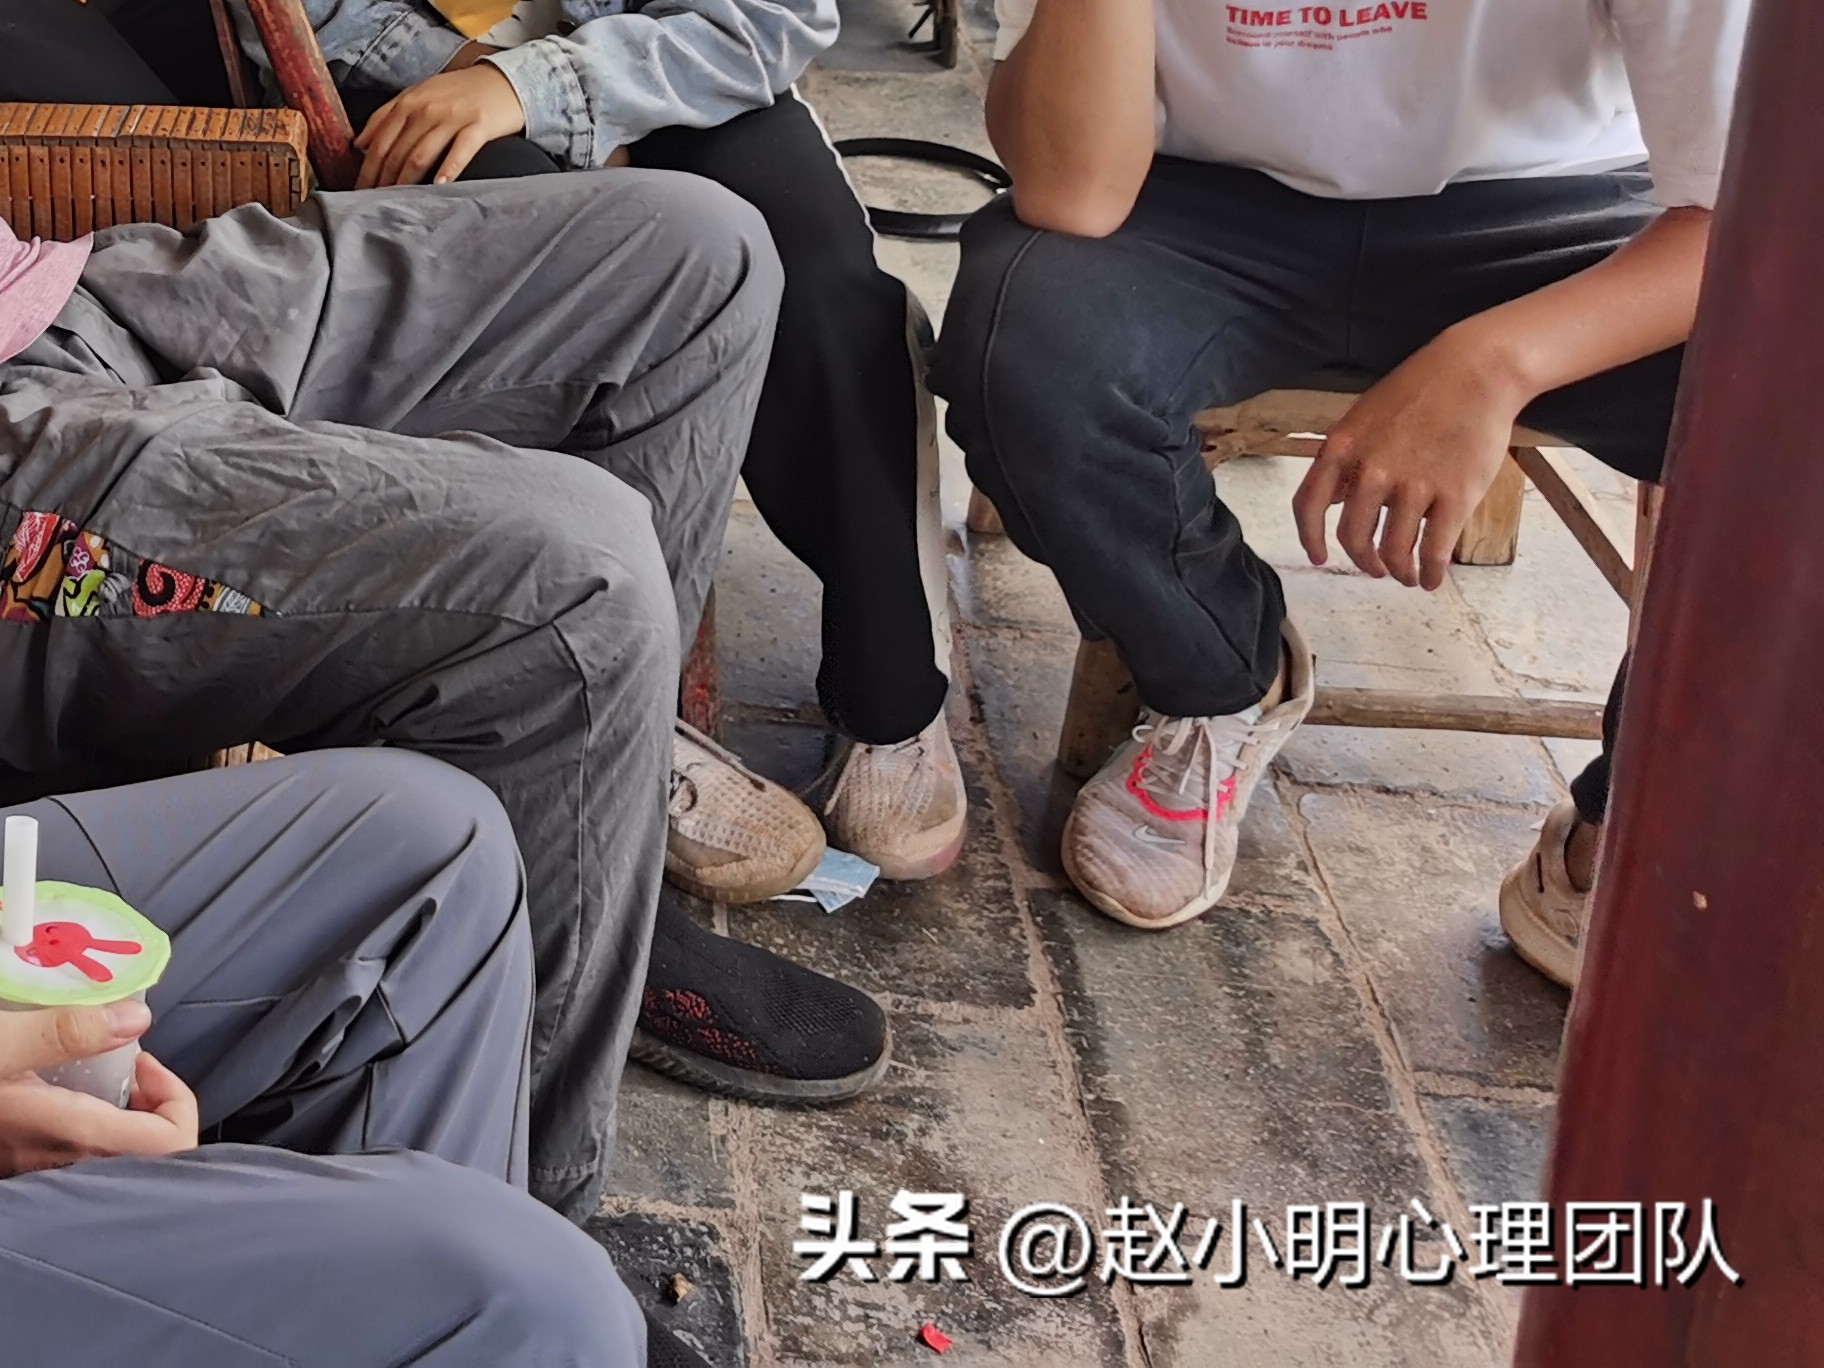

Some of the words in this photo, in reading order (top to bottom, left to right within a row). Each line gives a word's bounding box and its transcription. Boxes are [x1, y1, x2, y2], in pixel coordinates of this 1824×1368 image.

[1226, 4, 1293, 27] TIME
[1298, 6, 1332, 26] TO
[1339, 0, 1428, 27] LEAVE
